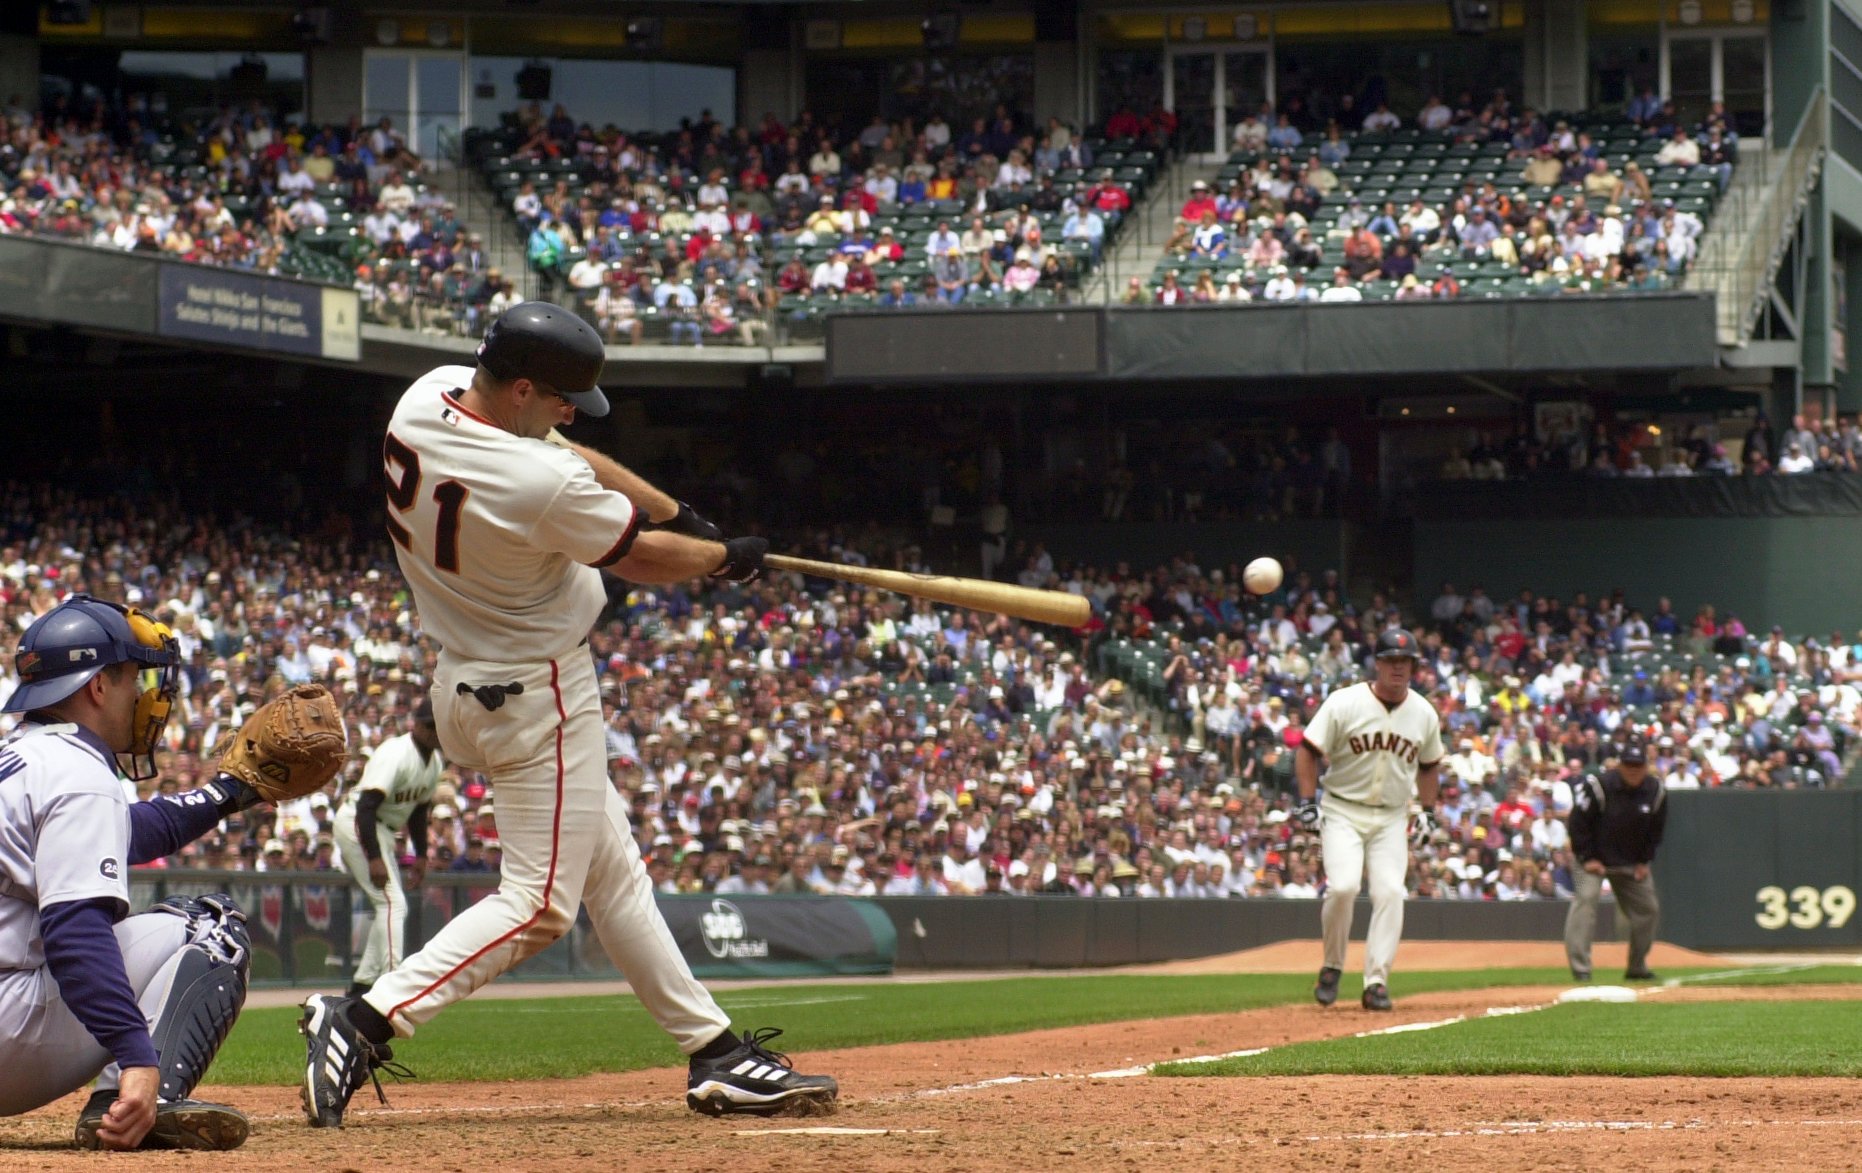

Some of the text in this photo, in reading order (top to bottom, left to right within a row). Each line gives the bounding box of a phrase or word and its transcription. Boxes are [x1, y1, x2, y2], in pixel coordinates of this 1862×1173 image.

[384, 431, 470, 575] 21
[1350, 730, 1420, 764] GIANTS
[1754, 885, 1856, 930] 339
